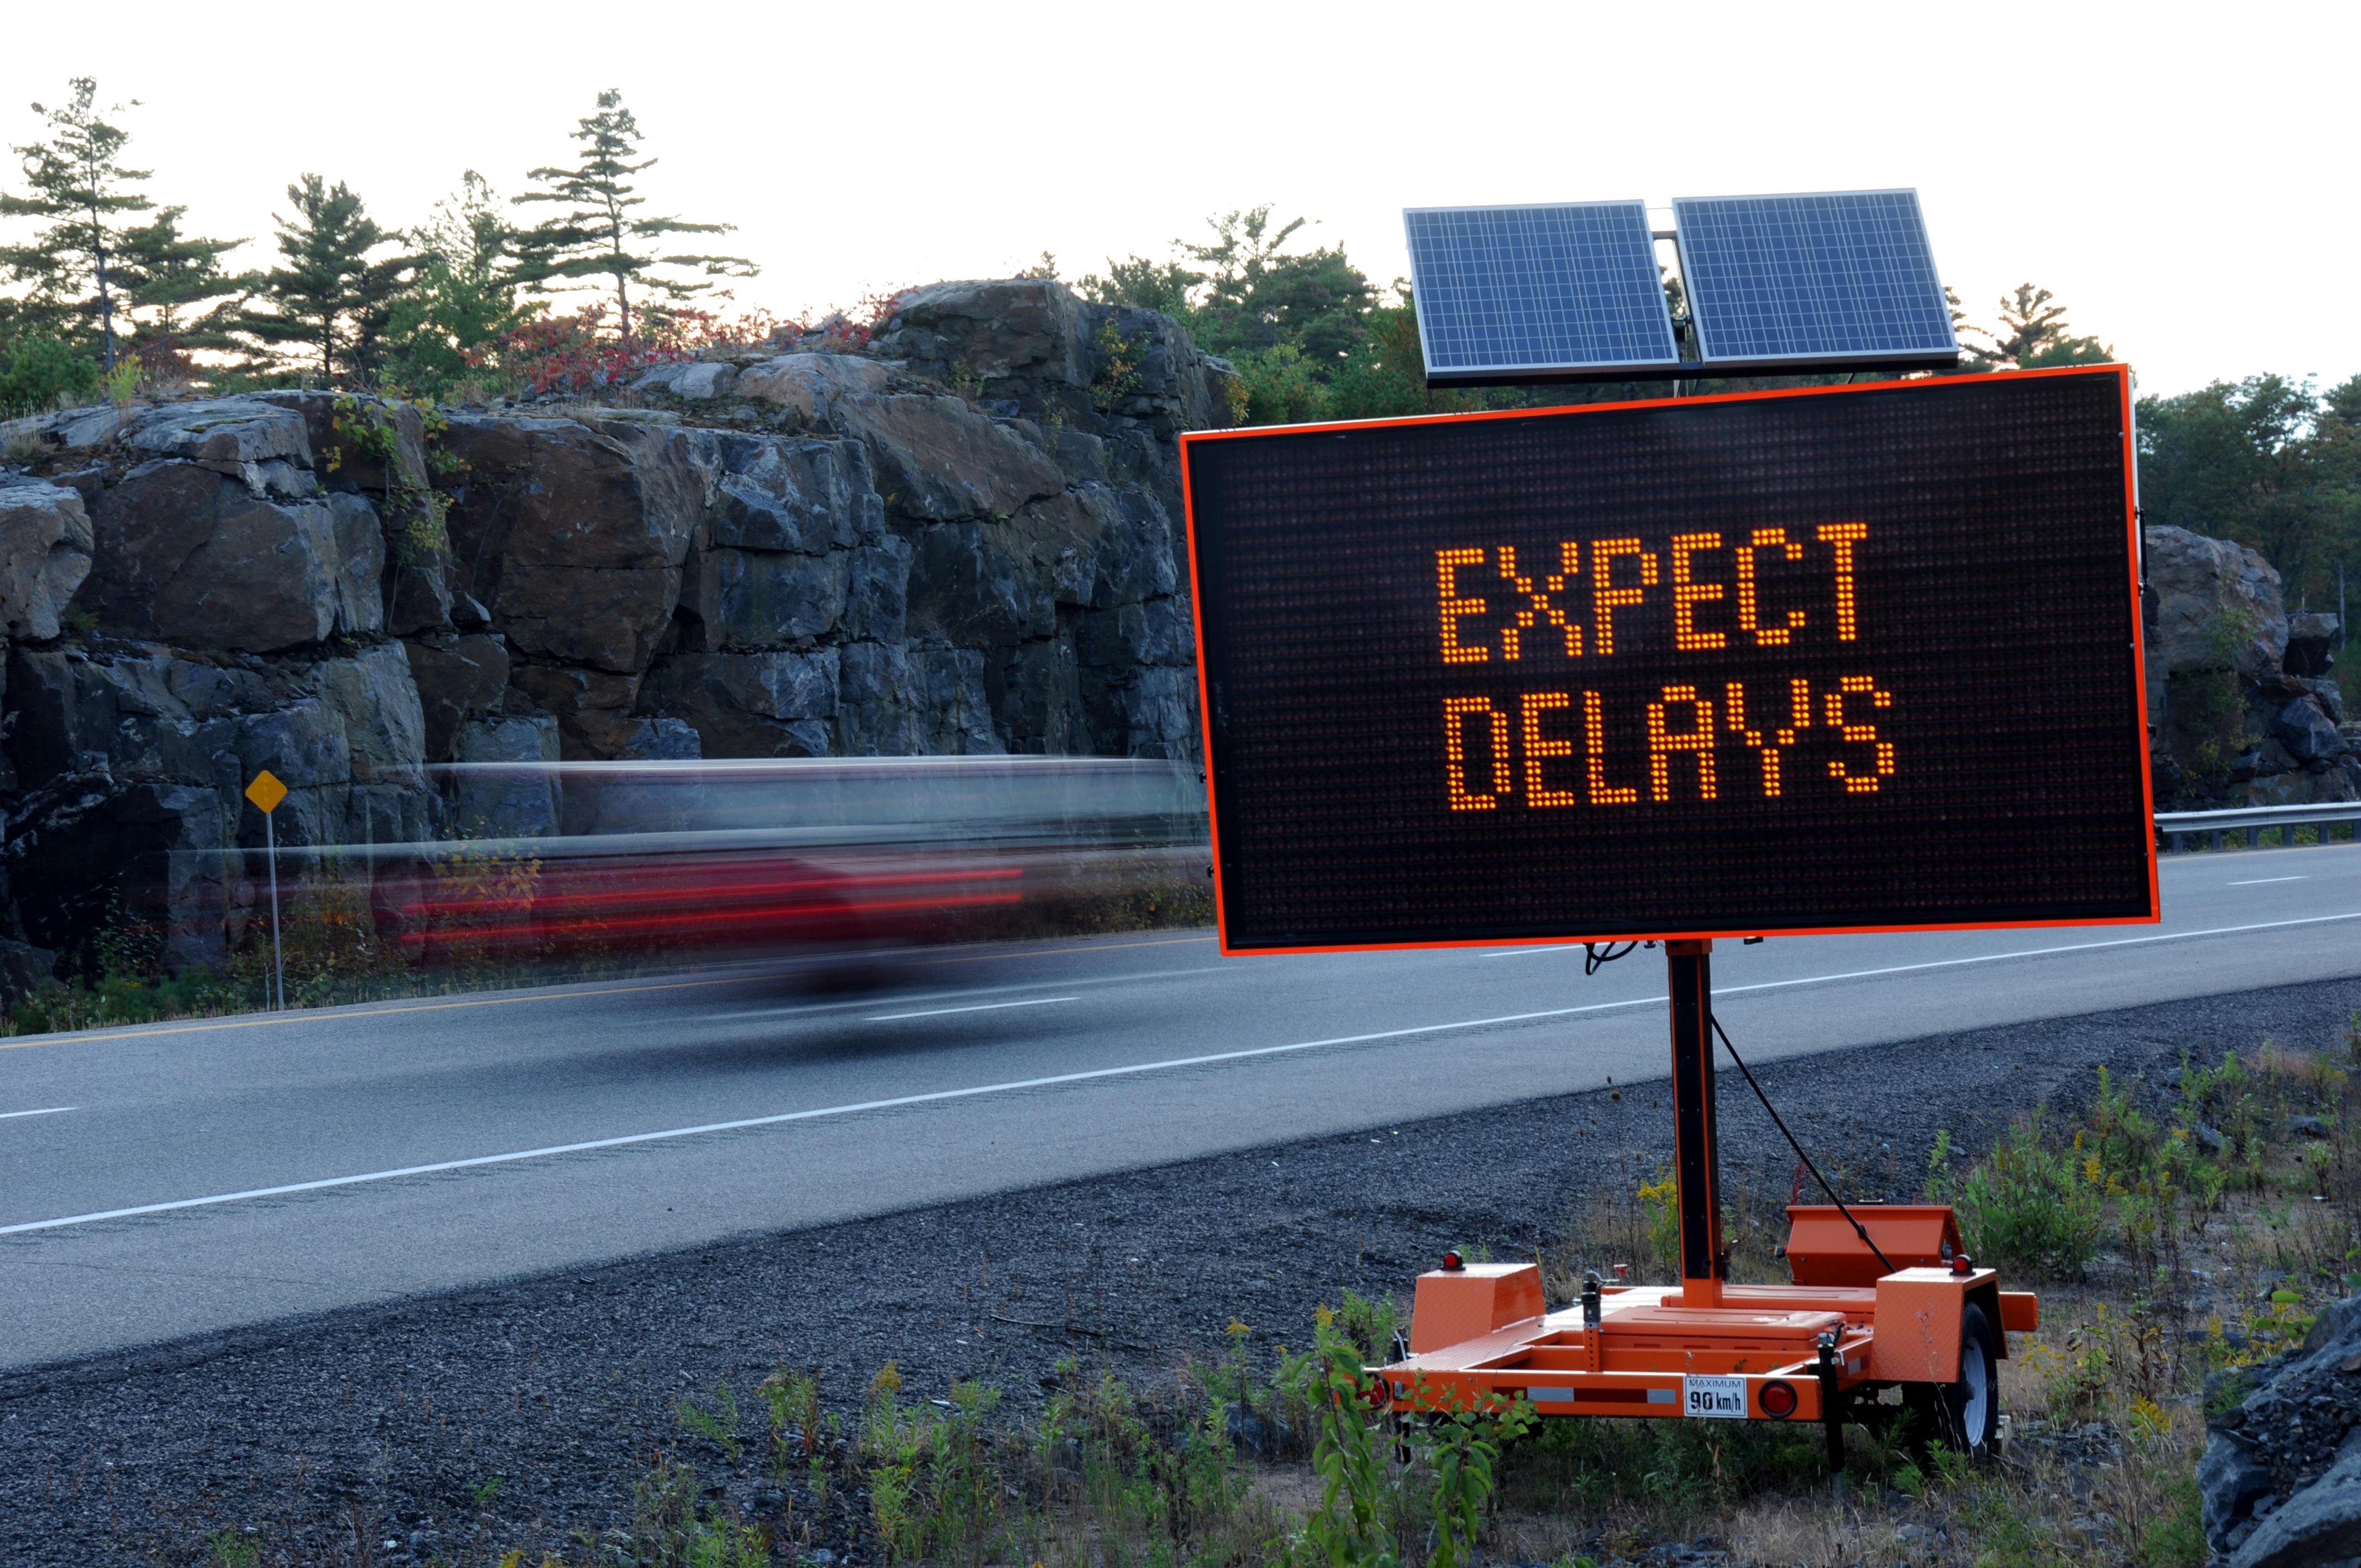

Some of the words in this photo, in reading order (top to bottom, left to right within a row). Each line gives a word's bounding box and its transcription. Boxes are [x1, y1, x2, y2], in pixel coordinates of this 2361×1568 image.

[1435, 522, 1868, 664] EXPECT
[1442, 676, 1895, 811] DELAYS
[1689, 1379, 1740, 1388] MAXIMUM
[1690, 1391, 1713, 1410] 90
[1716, 1392, 1741, 1413] km/h
